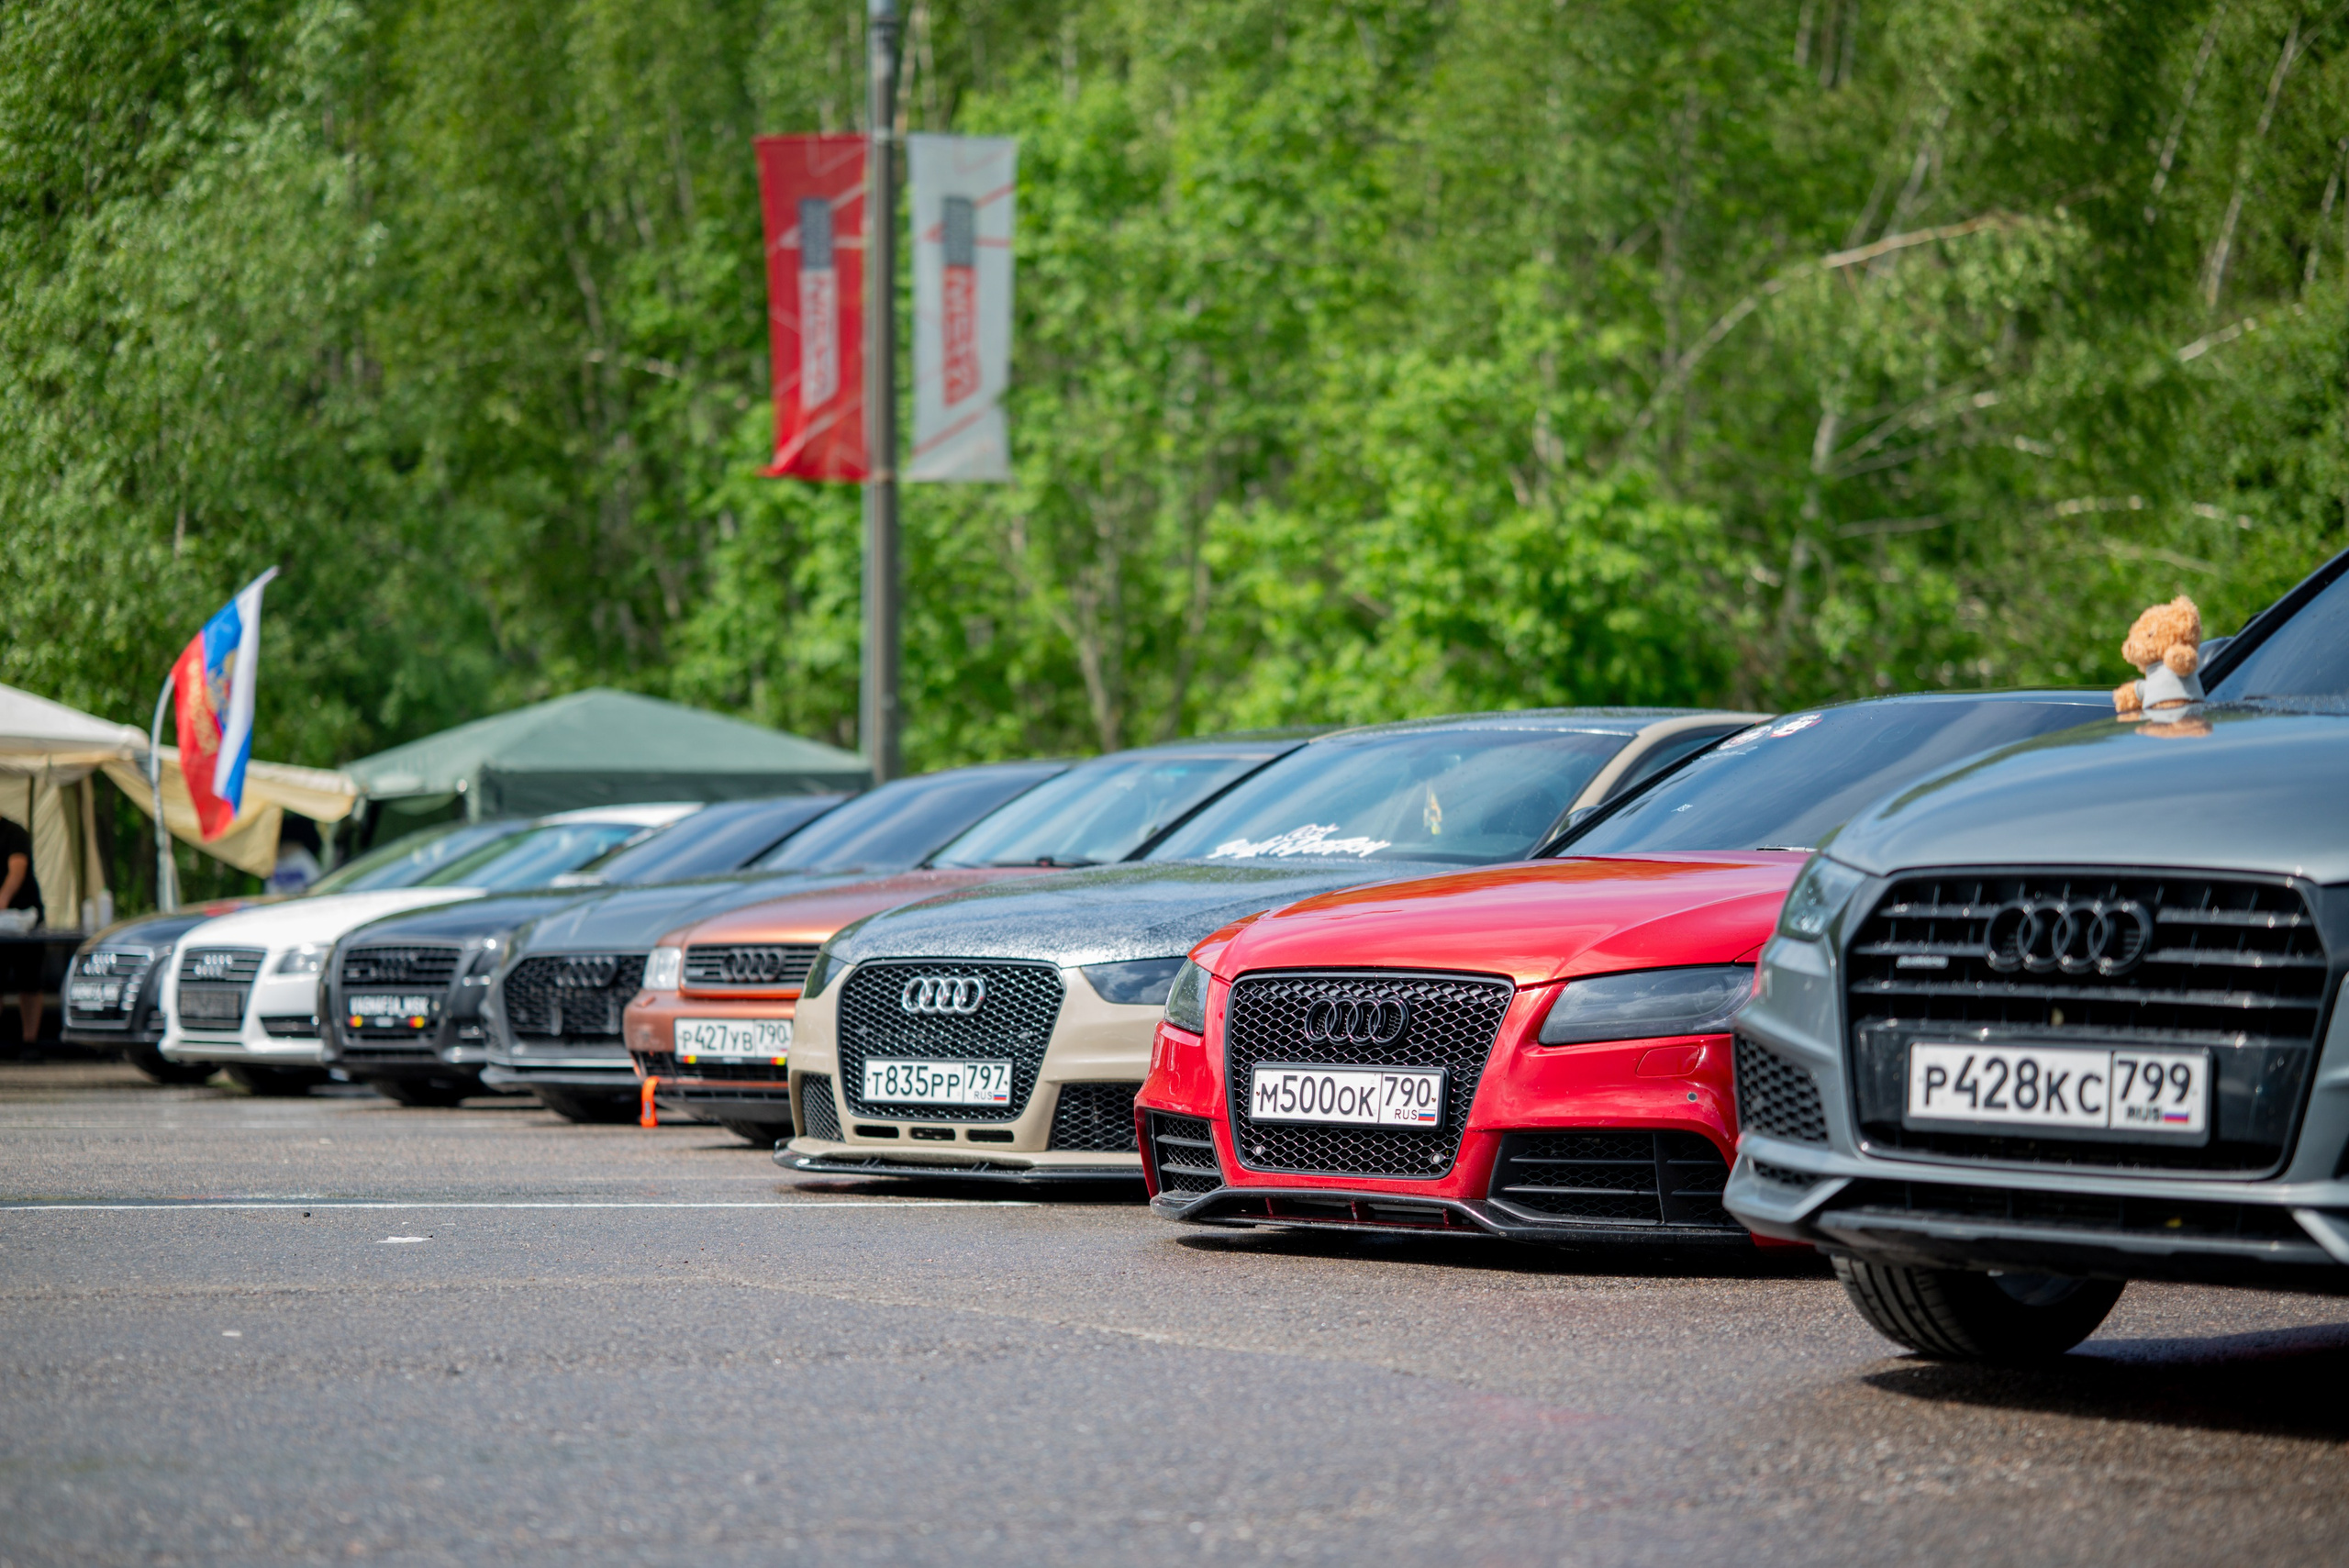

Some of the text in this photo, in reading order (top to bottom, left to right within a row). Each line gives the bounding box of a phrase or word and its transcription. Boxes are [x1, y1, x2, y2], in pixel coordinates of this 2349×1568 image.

[757, 1024, 787, 1044] 790
[966, 1064, 1006, 1090] 797
[2117, 1059, 2192, 1103] 799
[974, 1090, 993, 1100] RUS
[1385, 1076, 1431, 1107] 790
[1394, 1108, 1418, 1120] RUS
[2127, 1105, 2160, 1122] RUS
